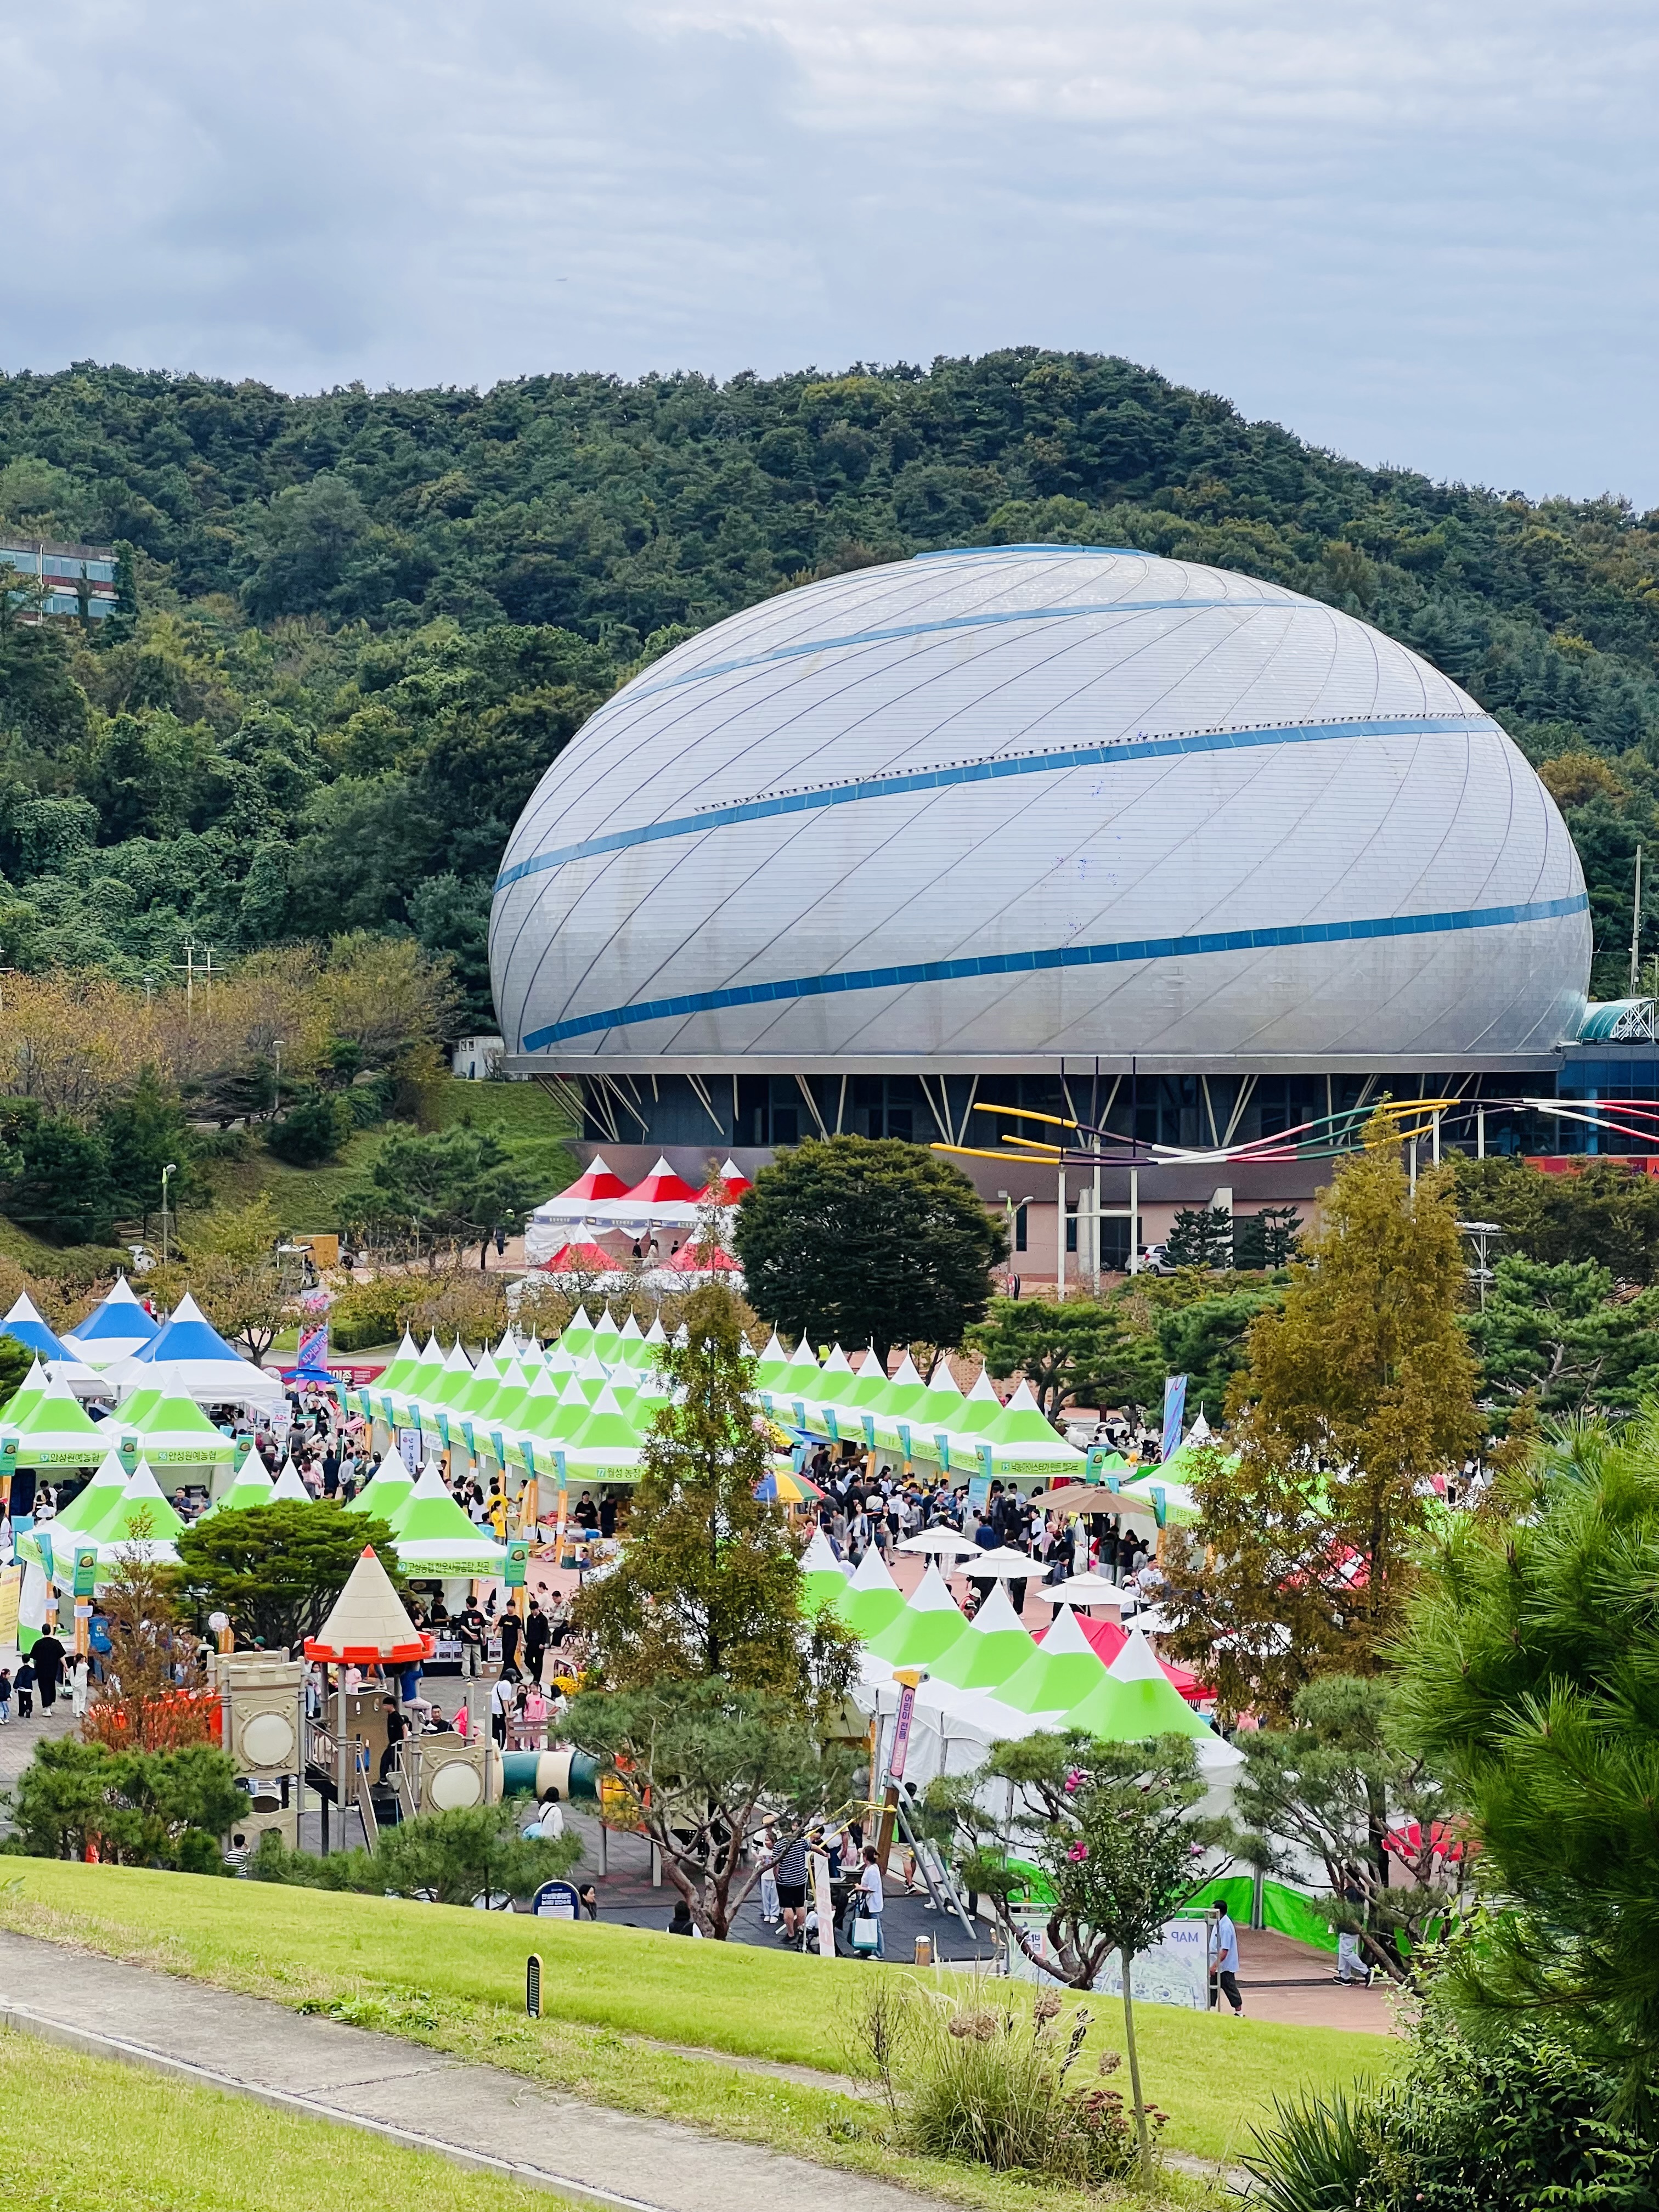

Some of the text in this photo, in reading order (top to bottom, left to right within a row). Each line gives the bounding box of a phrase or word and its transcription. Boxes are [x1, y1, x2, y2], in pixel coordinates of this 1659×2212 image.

[41, 1453, 100, 1463] 57 안성원예농협
[168, 1451, 217, 1462] 안성원예농협
[1002, 1463, 1009, 1471] 15
[597, 1468, 641, 1478] 77 월성 농장
[902, 1694, 912, 1720] 어린이
